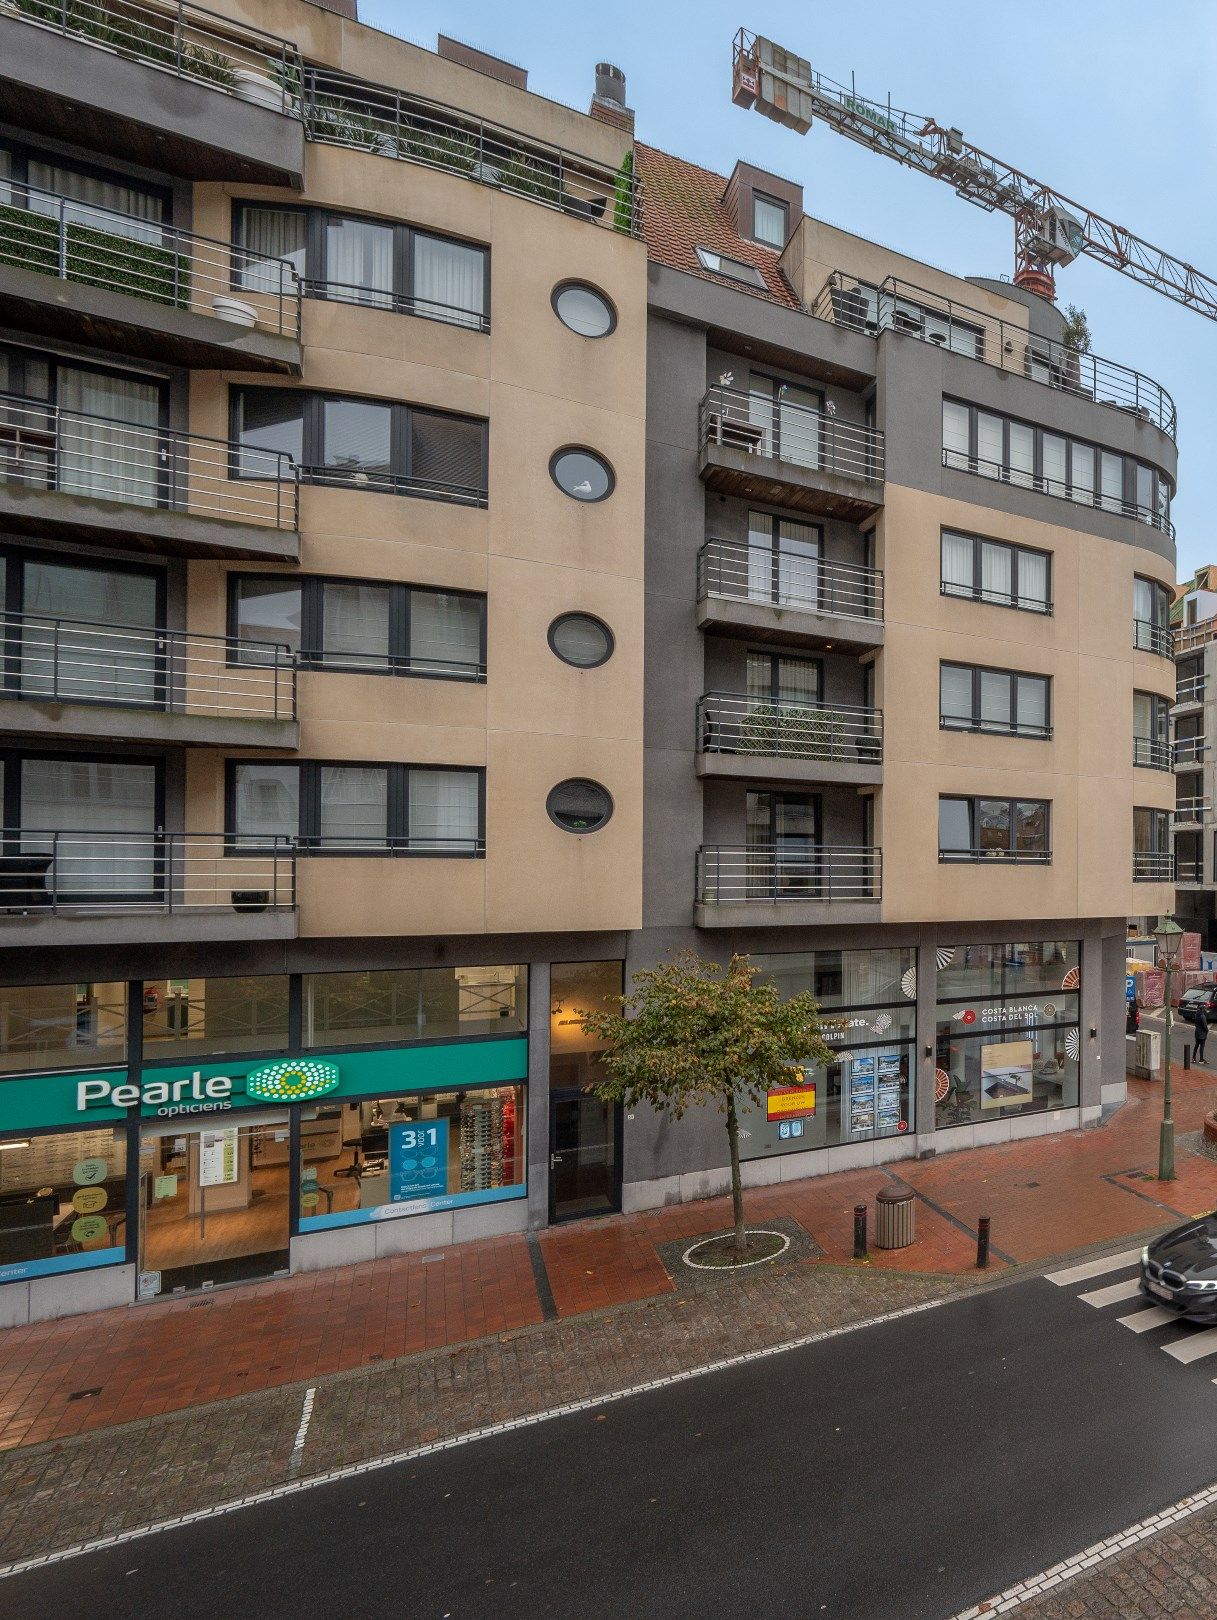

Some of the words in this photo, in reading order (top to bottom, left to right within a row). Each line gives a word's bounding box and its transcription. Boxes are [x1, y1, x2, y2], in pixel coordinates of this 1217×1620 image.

[847, 98, 895, 132] ROMAR
[981, 1008, 1007, 1016] COSTA
[981, 1015, 1007, 1023] COSTA
[822, 1032, 845, 1040] COLPIN
[77, 1071, 233, 1111] Pearle
[157, 1100, 232, 1118] opticiens
[401, 1130, 417, 1149] 3
[426, 1128, 436, 1145] 1
[430, 1200, 454, 1208] Center
[0, 1268, 29, 1277] enter
